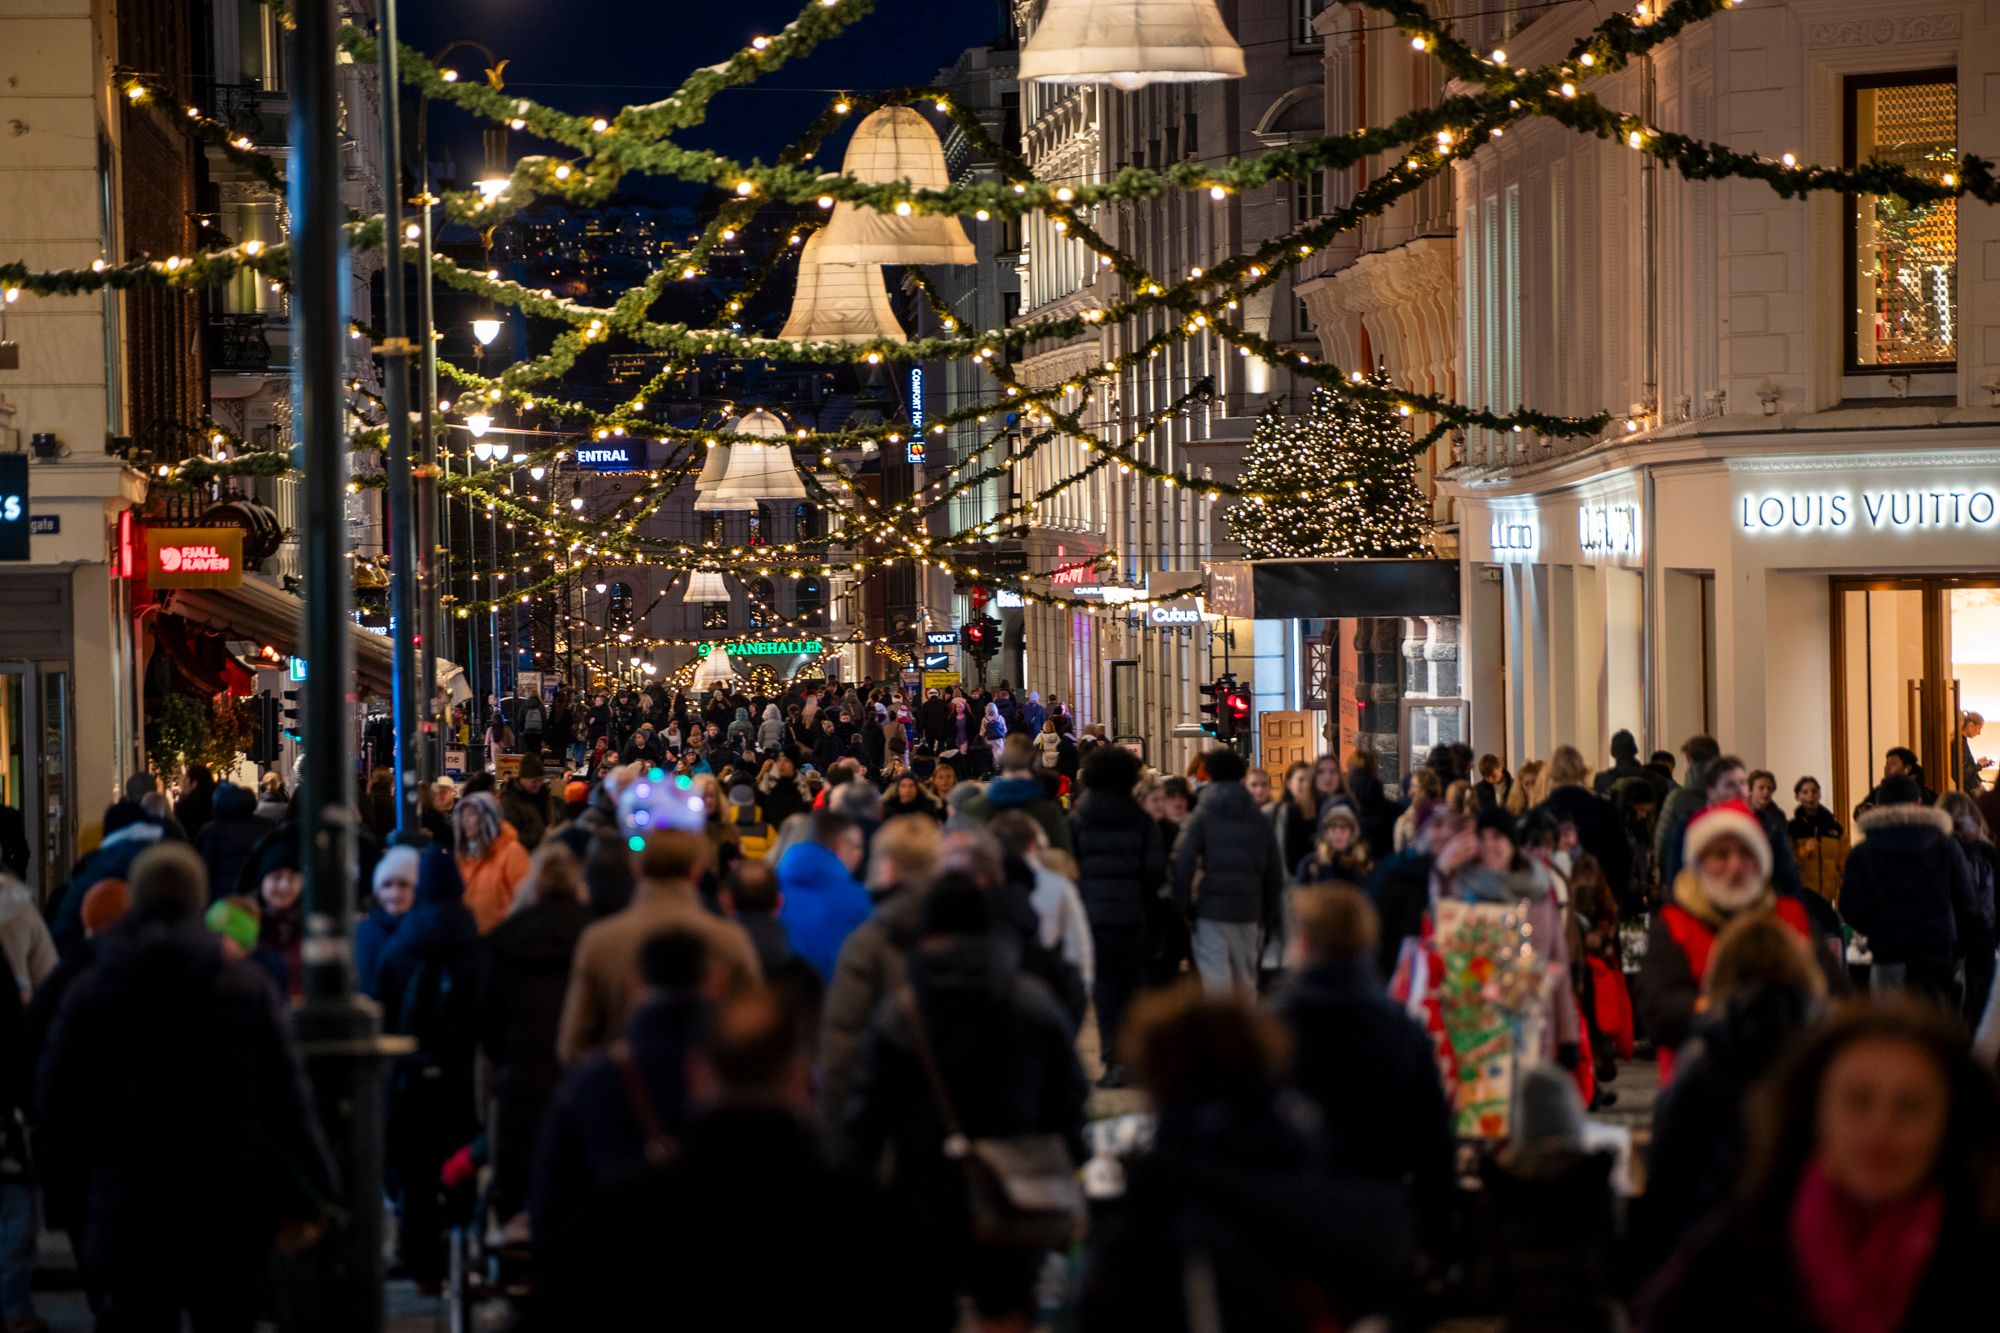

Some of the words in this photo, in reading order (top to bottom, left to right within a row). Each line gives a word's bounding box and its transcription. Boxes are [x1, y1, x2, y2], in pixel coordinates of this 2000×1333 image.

[912, 368, 921, 410] COMFORT
[576, 450, 629, 462] ENTRAL
[1743, 495, 1847, 527] LOUIS
[1152, 607, 1199, 623] Cubus
[928, 634, 955, 643] VOLT
